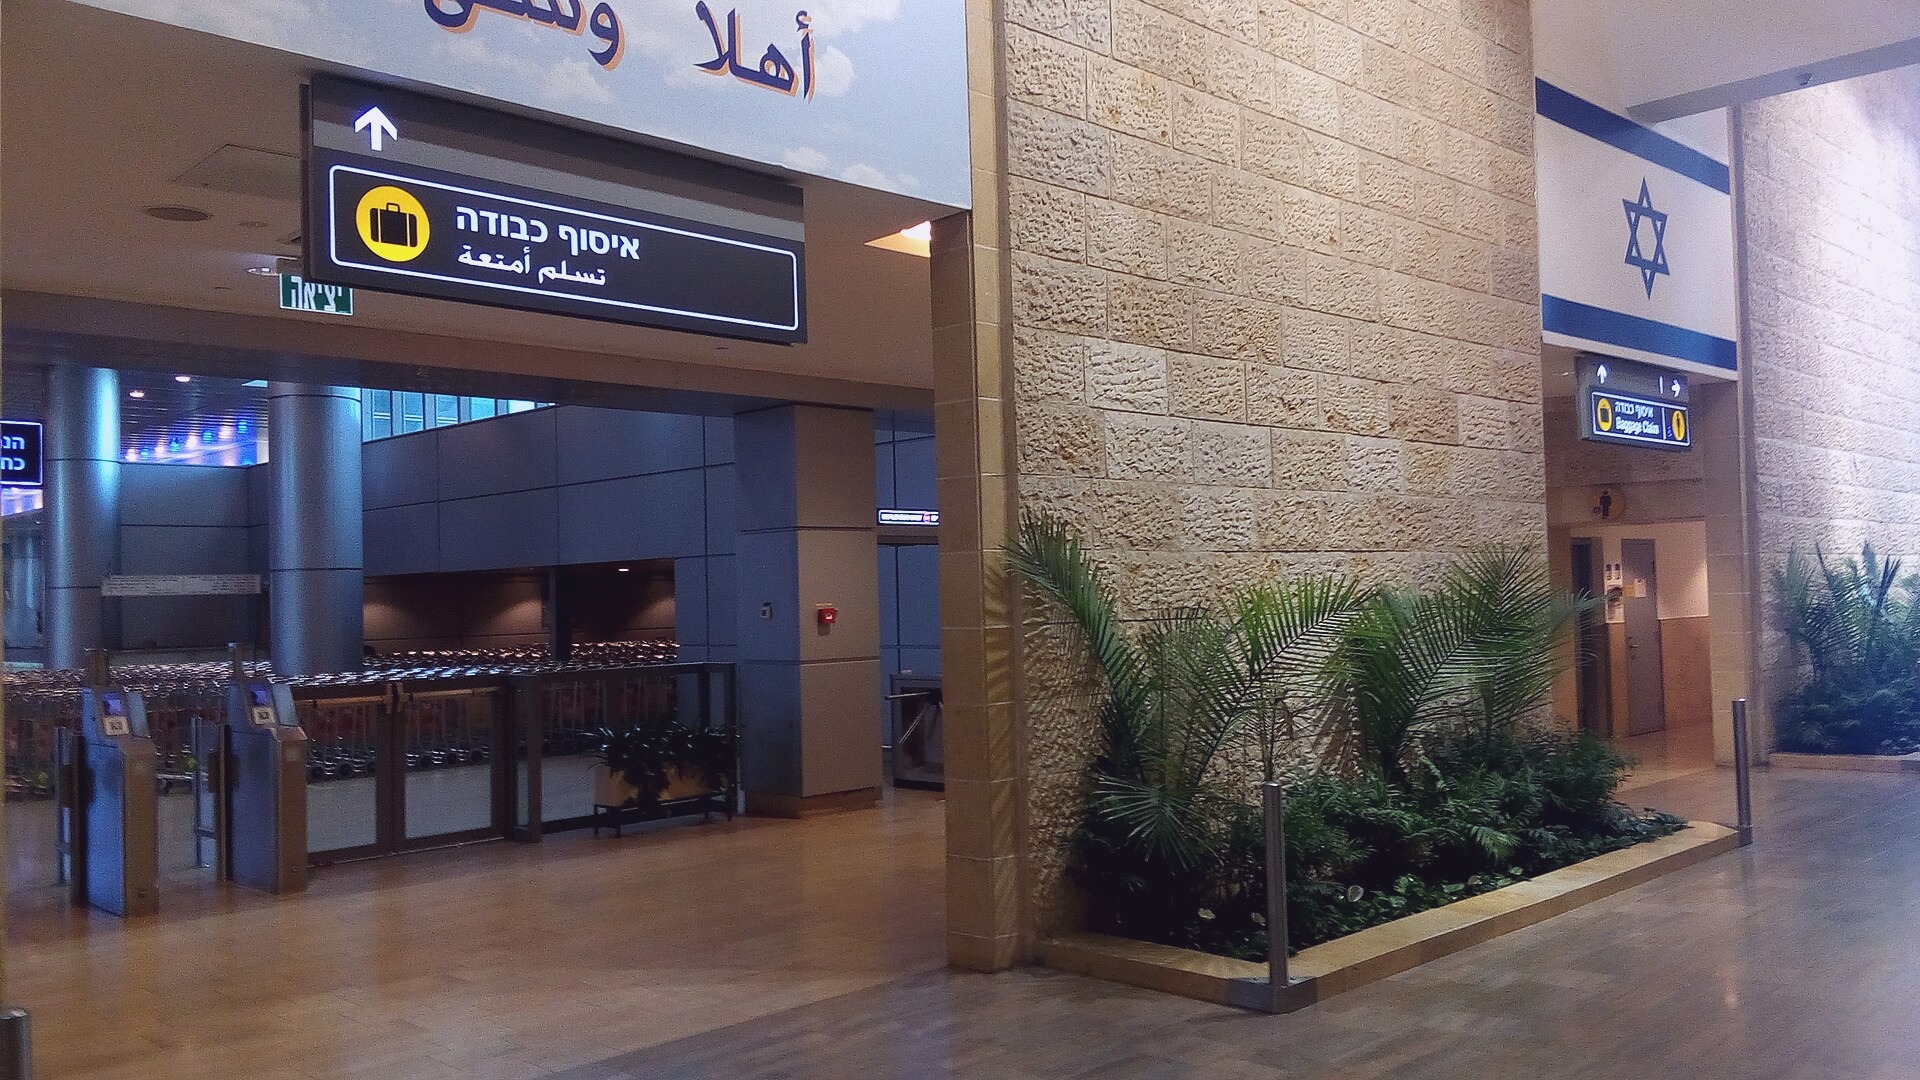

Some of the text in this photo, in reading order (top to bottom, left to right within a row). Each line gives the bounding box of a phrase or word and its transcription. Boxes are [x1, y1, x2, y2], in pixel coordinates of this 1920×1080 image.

[693, 0, 816, 103] أهلا
[455, 205, 641, 261] איסוף כבודה
[457, 244, 606, 286] تسلم أمتعة
[290, 275, 343, 313] יציאה
